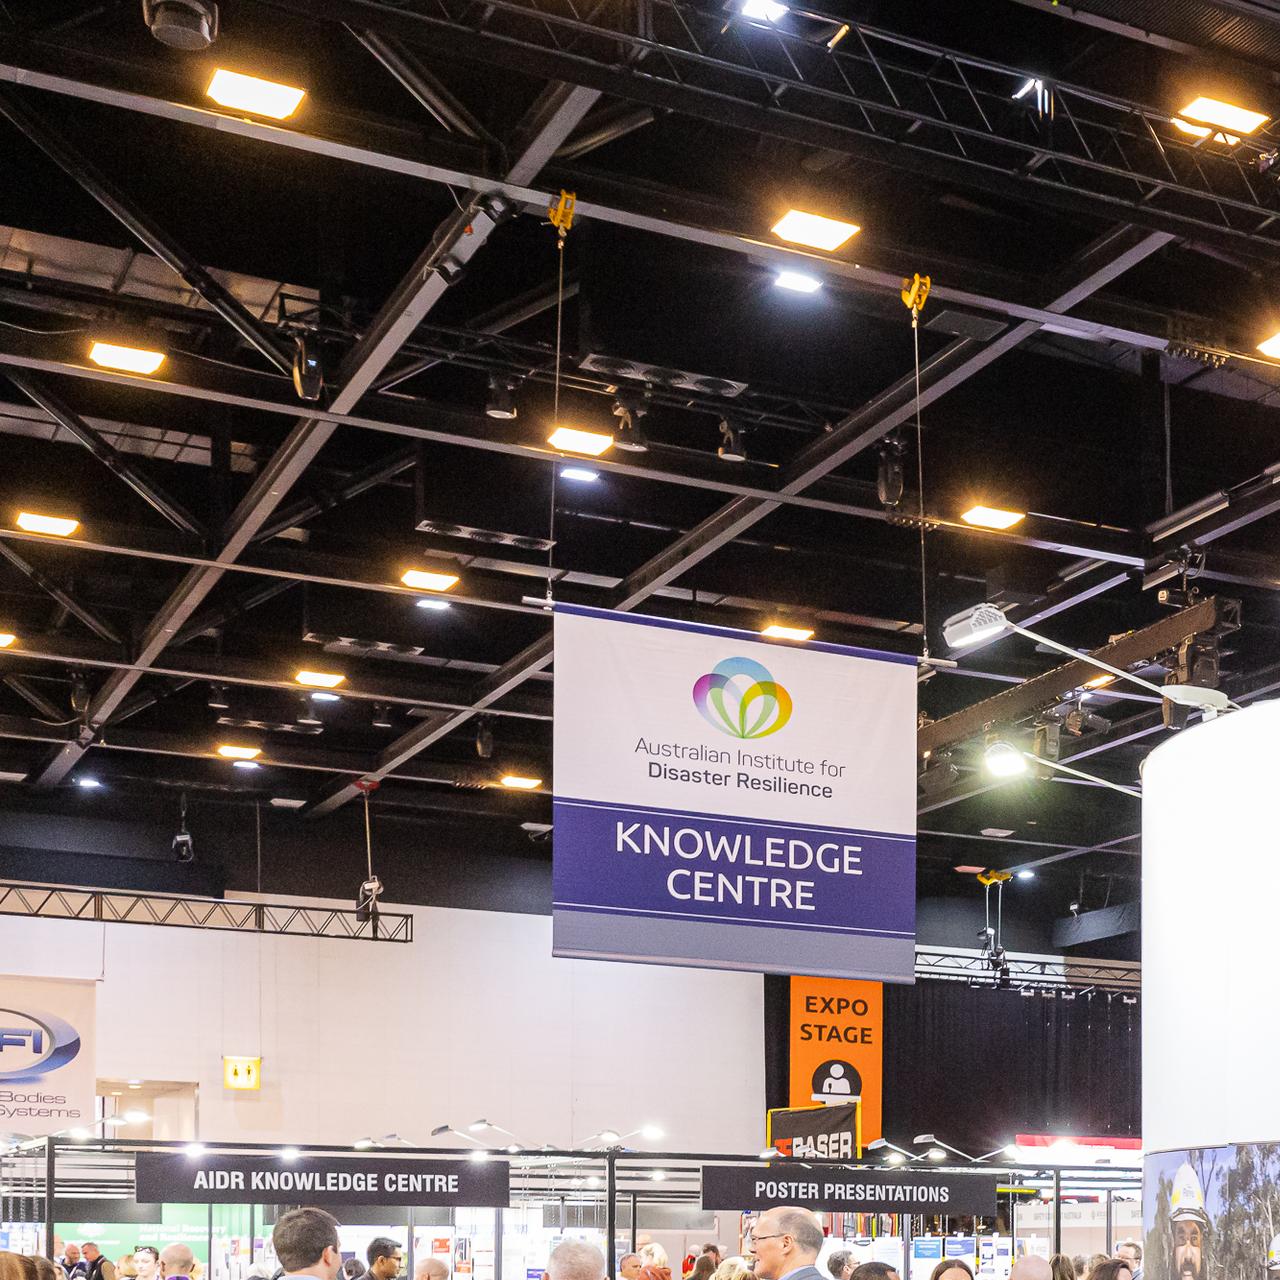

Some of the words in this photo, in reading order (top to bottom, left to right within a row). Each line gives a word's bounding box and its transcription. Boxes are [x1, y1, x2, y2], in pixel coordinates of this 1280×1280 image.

[634, 737, 731, 764] Australian
[737, 750, 814, 774] Institute
[820, 759, 846, 778] for
[648, 762, 731, 787] Disaster
[737, 774, 833, 798] Resilience
[616, 821, 863, 875] KNOWLEDGE
[667, 869, 815, 911] CENTRE
[805, 996, 868, 1016] EXPO
[800, 1024, 873, 1044] STAGE
[193, 1170, 245, 1190] AIDR
[251, 1171, 378, 1192] KNOWLEDGE
[384, 1173, 459, 1193] CENTRE
[755, 1181, 819, 1199] POSTER
[824, 1184, 950, 1202] PRESENTATIONS
